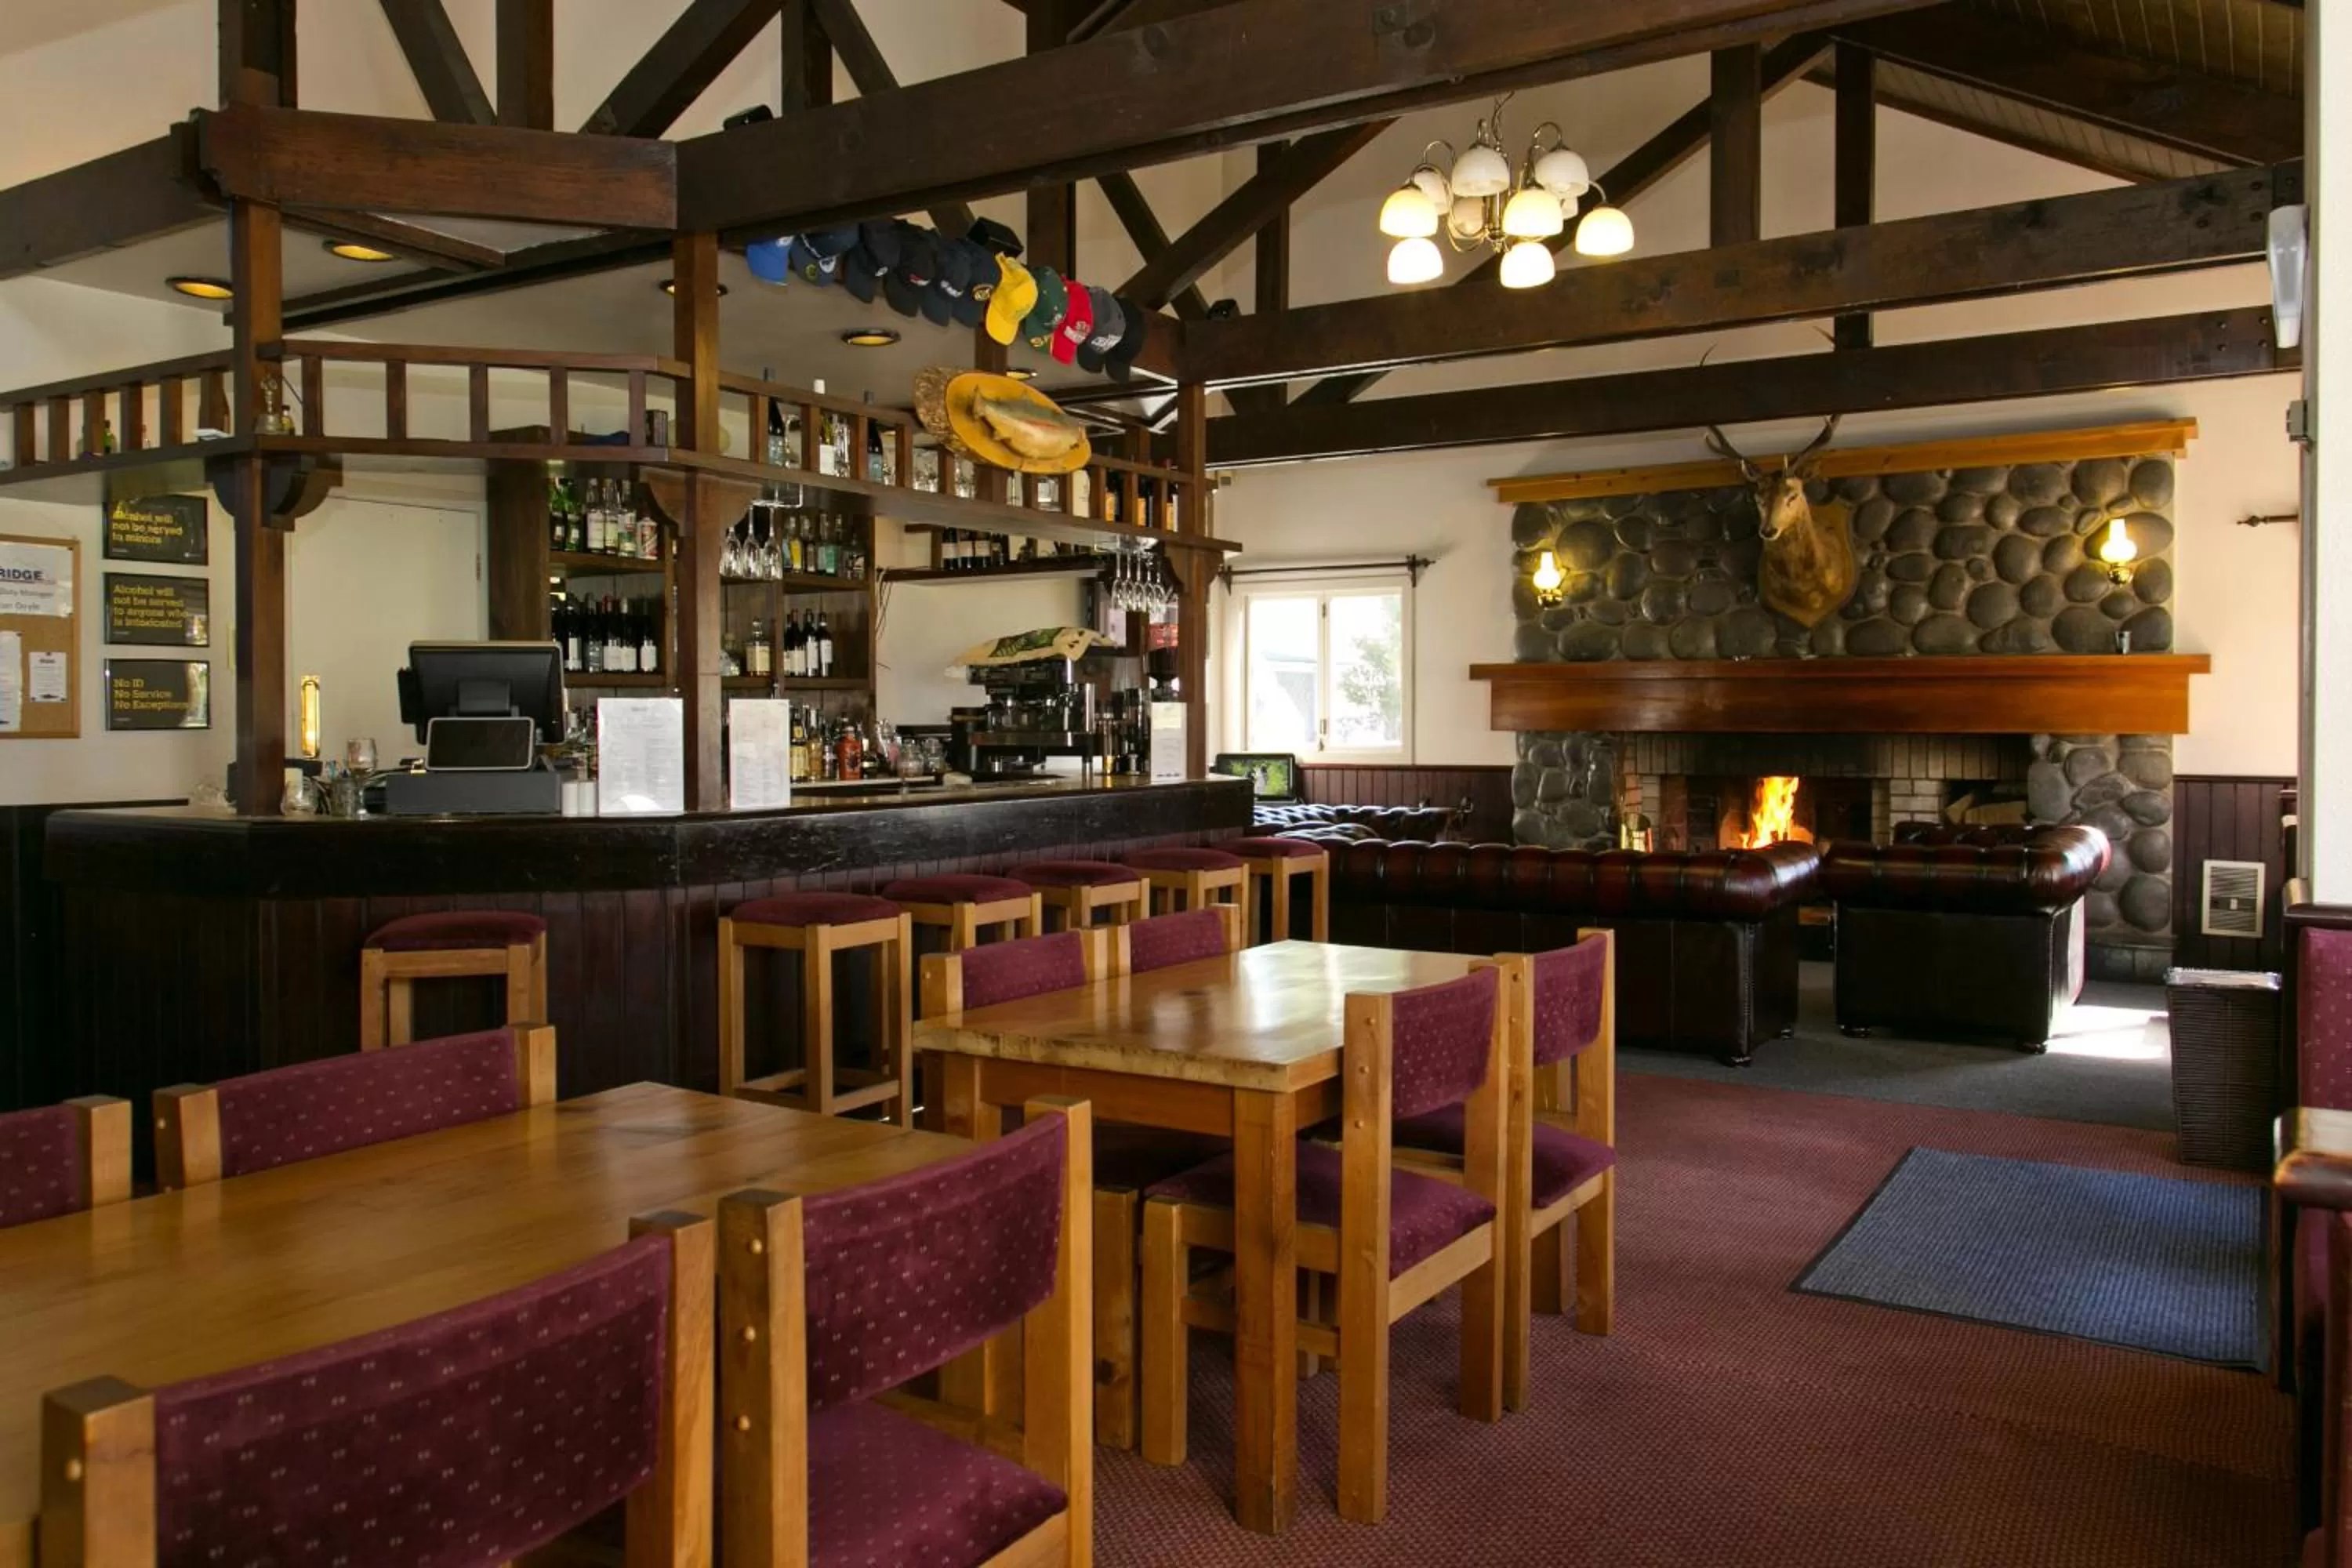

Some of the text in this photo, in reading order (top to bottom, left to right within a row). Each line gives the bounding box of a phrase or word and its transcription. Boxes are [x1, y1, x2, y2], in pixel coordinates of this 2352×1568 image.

[147, 525, 183, 536] served
[113, 584, 174, 596] Alcohol will
[113, 678, 145, 688] No ID
[114, 690, 172, 699] No Service
[114, 700, 131, 710] No
